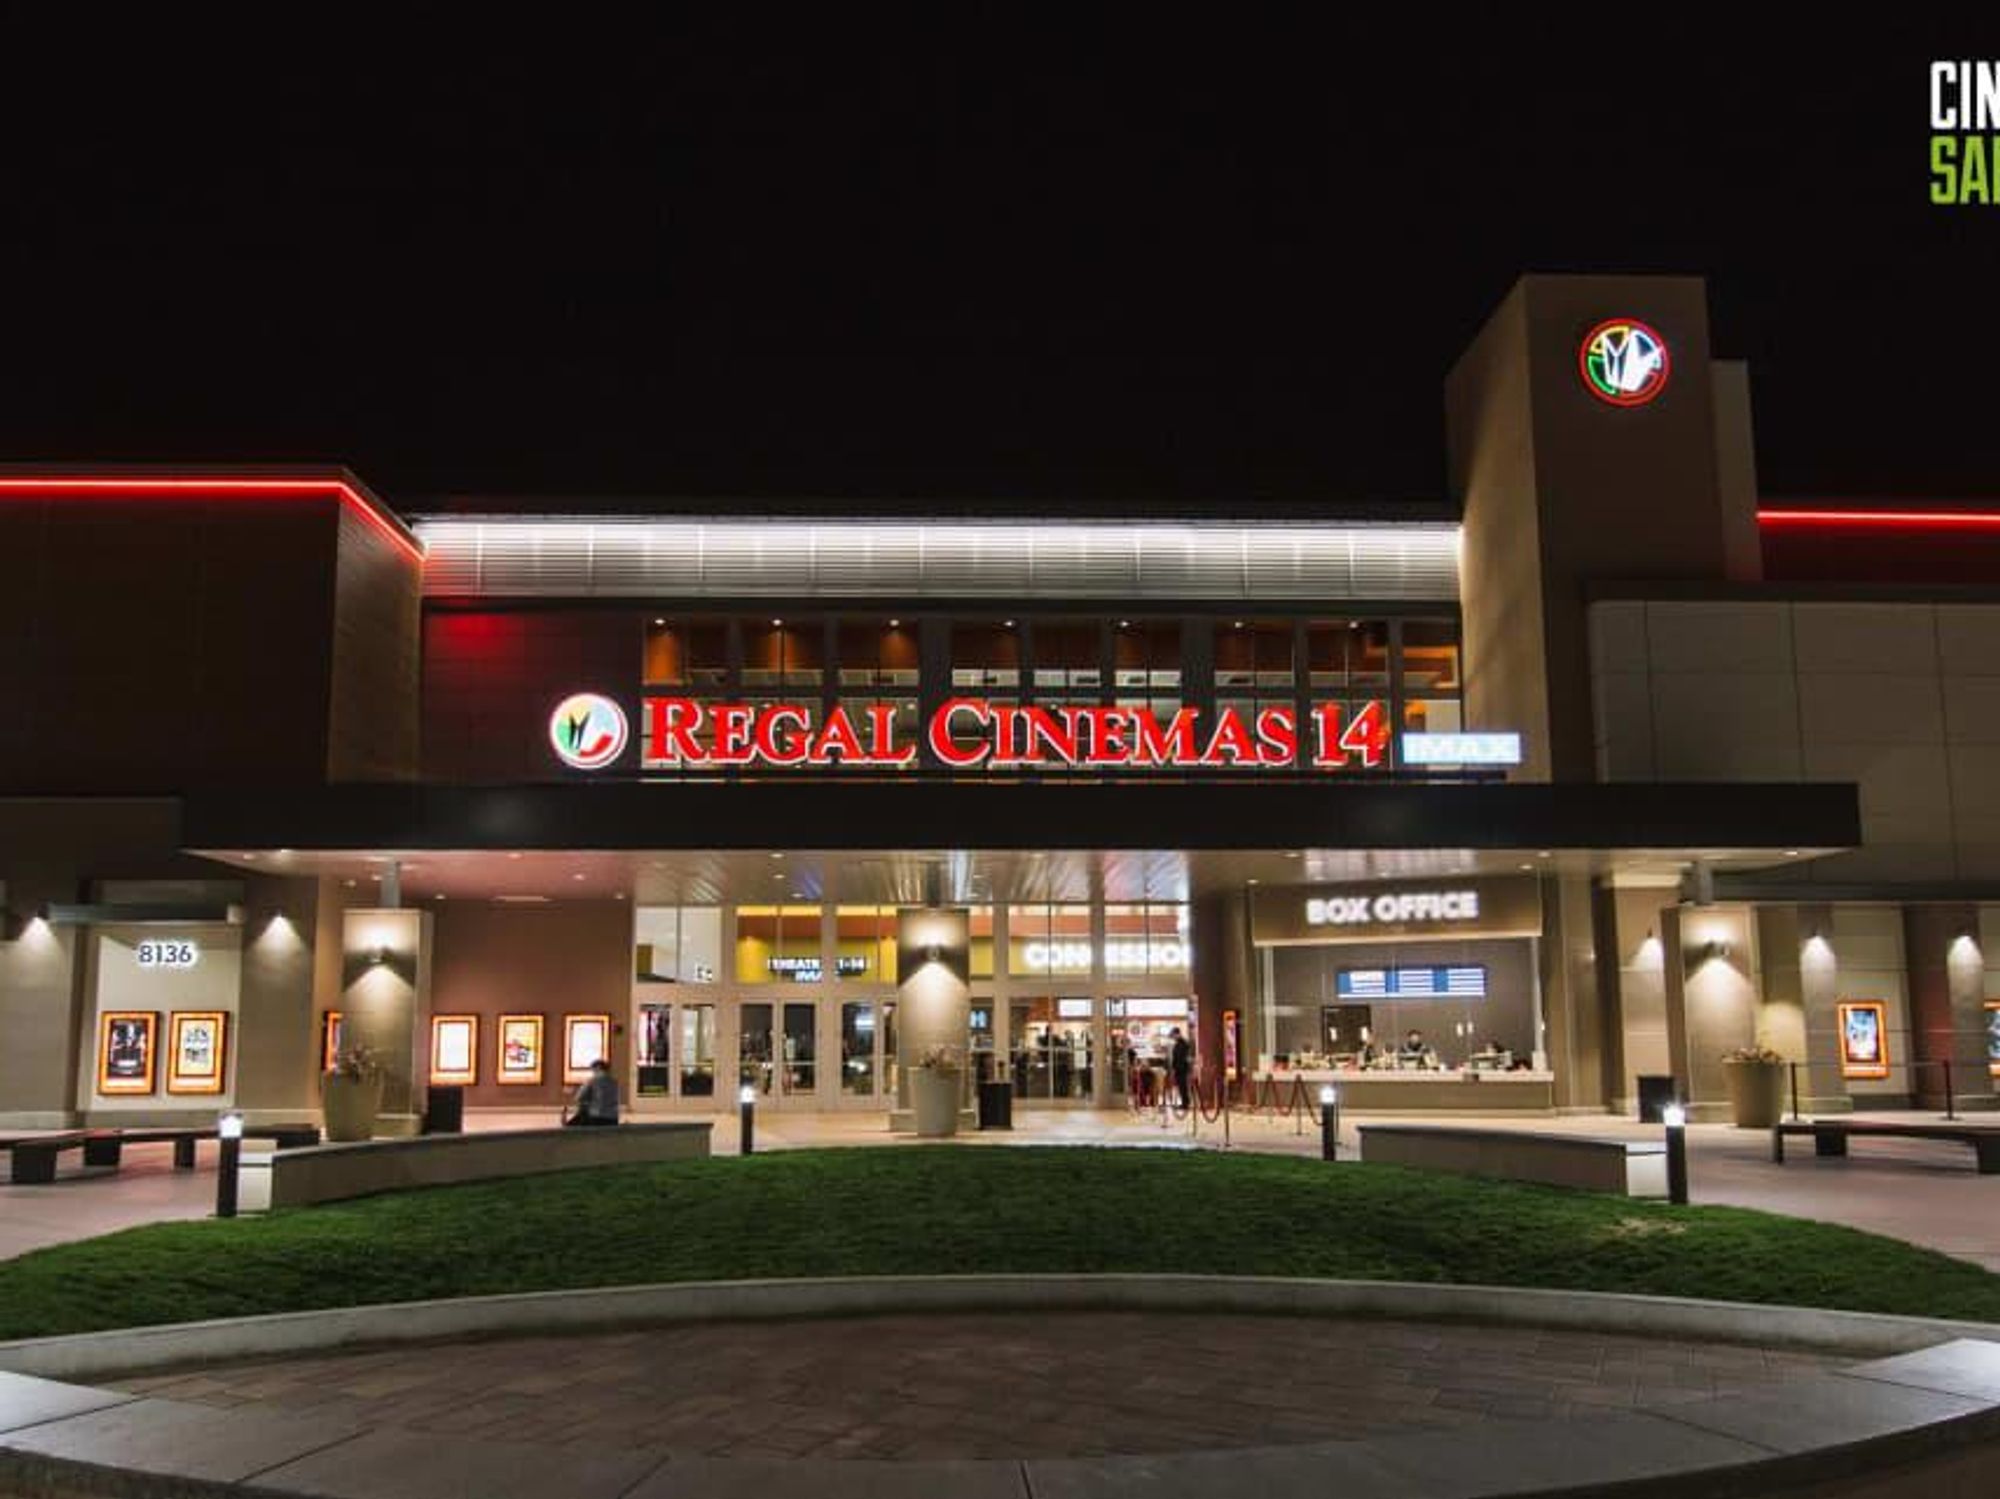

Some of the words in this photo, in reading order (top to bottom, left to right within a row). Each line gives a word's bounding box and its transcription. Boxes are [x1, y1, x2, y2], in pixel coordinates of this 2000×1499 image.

[644, 696, 916, 766] REGAL
[928, 696, 1297, 768] CINEMAS
[1312, 698, 1392, 768] 14
[1307, 898, 1370, 924] BOX
[1374, 892, 1478, 921] OFFICE
[139, 944, 192, 963] 8136
